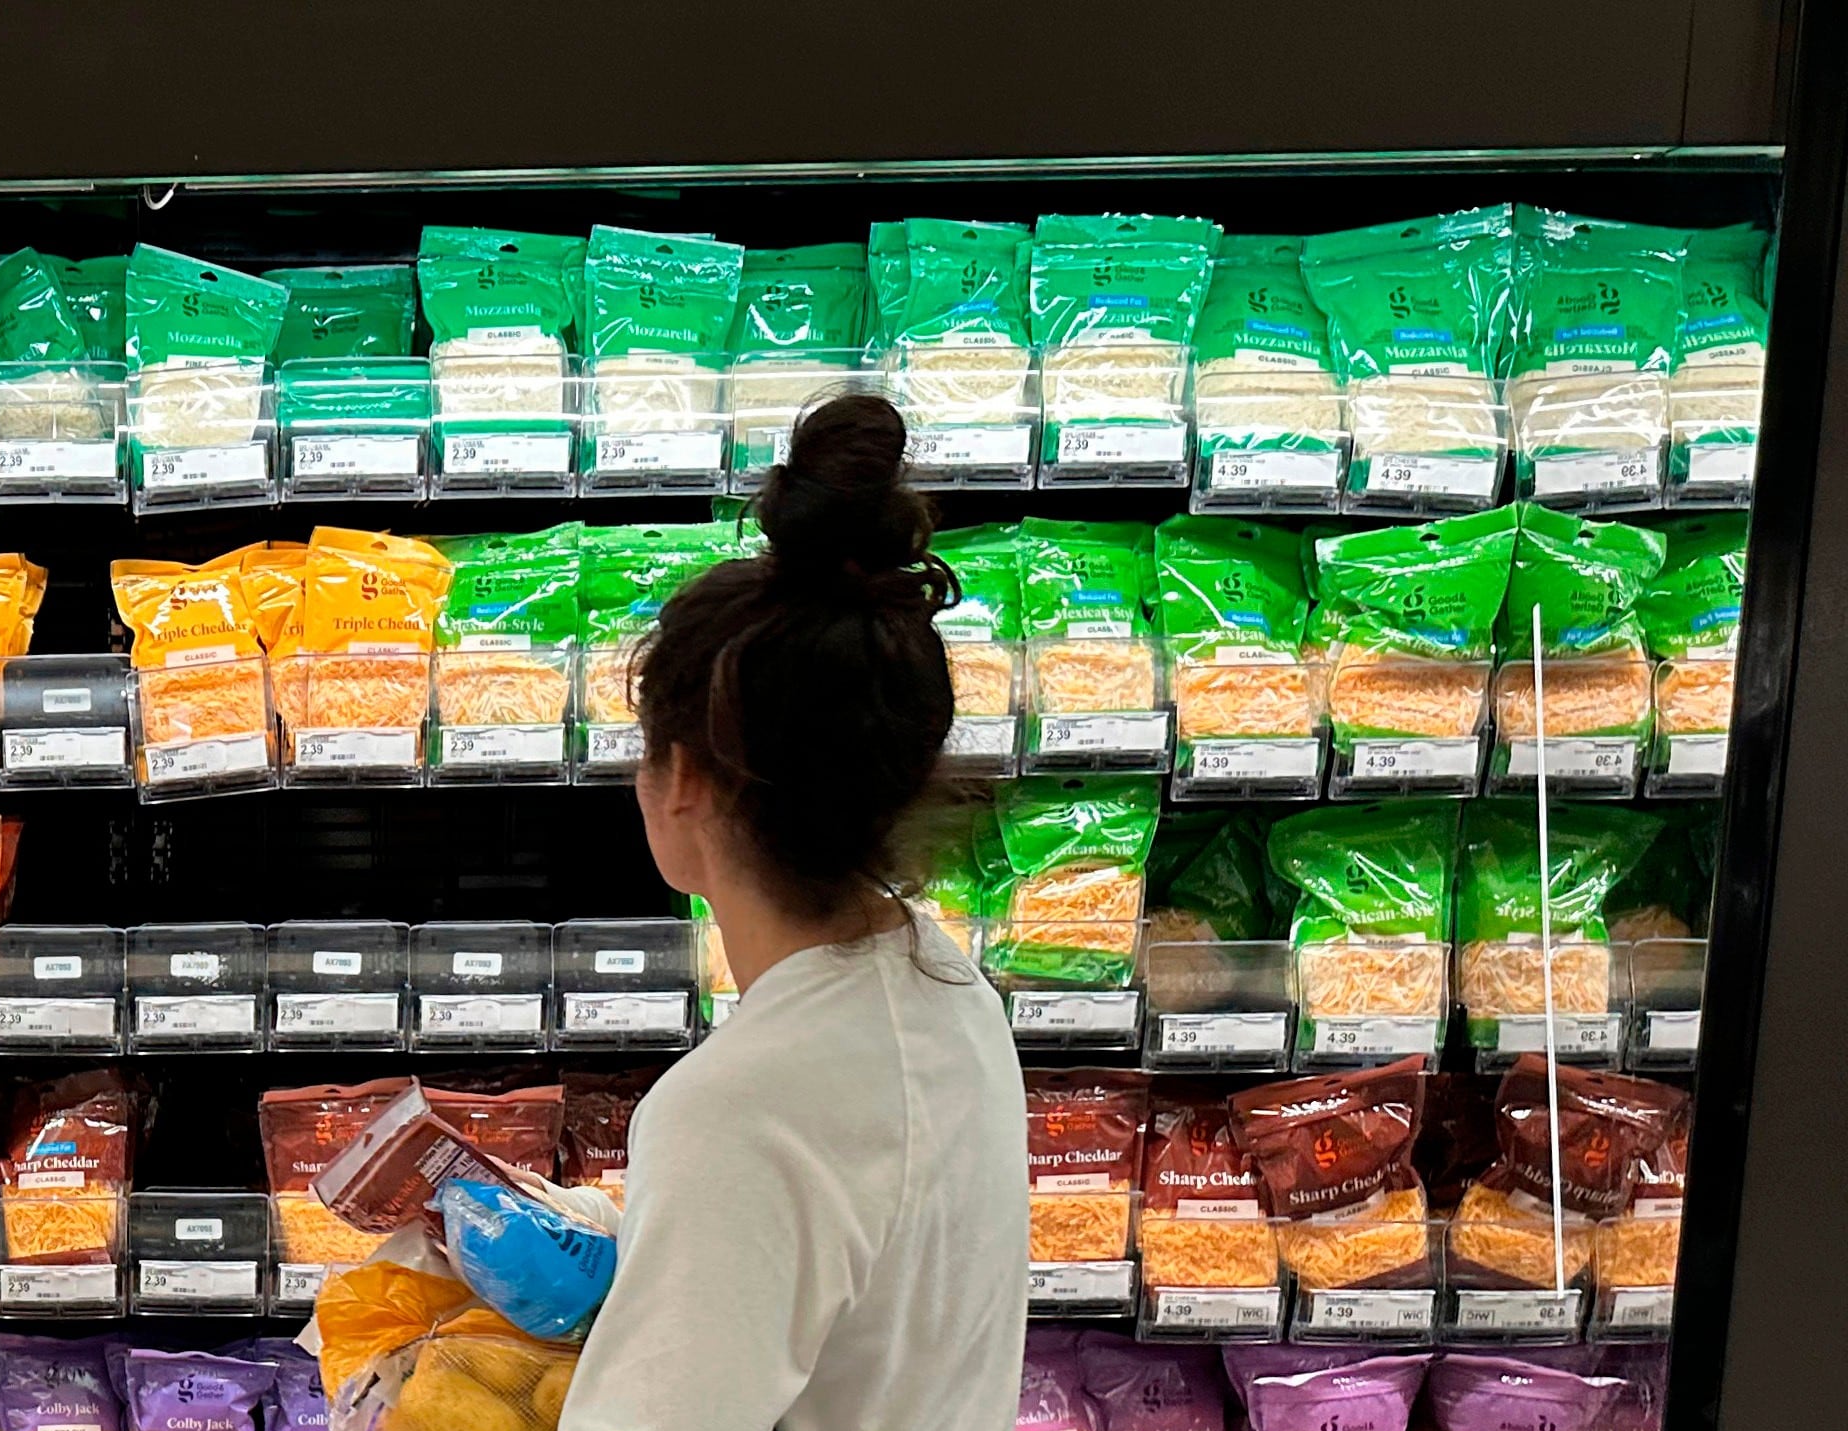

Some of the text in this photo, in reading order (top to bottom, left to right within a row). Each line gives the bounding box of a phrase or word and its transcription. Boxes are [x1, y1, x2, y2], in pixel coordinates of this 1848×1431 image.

[465, 303, 541, 317] Mozzarella
[627, 322, 698, 342] Mozzarella
[167, 331, 242, 349] Mozzarella
[1232, 331, 1321, 356] Mozzarella
[1384, 346, 1468, 358] Mozzarella
[1258, 355, 1297, 366] CLASSIC
[601, 447, 625, 459] 2.39
[152, 463, 175, 475] 2.39
[1218, 464, 1247, 476] 4.39
[1382, 469, 1411, 480] 4.39
[1047, 729, 1070, 741] 2.39
[301, 744, 323, 755] 2.39
[1200, 757, 1229, 769] 4.39
[1366, 755, 1396, 768] 4.39
[144, 1012, 165, 1022] 2.39
[575, 1009, 598, 1020] 2.39
[1168, 1032, 1197, 1043] 4.39
[1327, 1032, 1356, 1045] 4.39
[586, 1147, 626, 1160] Sharp
[8, 1282, 30, 1293] 2.39
[1164, 1304, 1191, 1316] 4.39
[1242, 1309, 1263, 1318] WIC
[1324, 1307, 1353, 1319] 4.39
[1402, 1310, 1424, 1321] WIC
[36, 1402, 100, 1417] Colby Jack
[167, 1417, 234, 1431] Colby Jack
